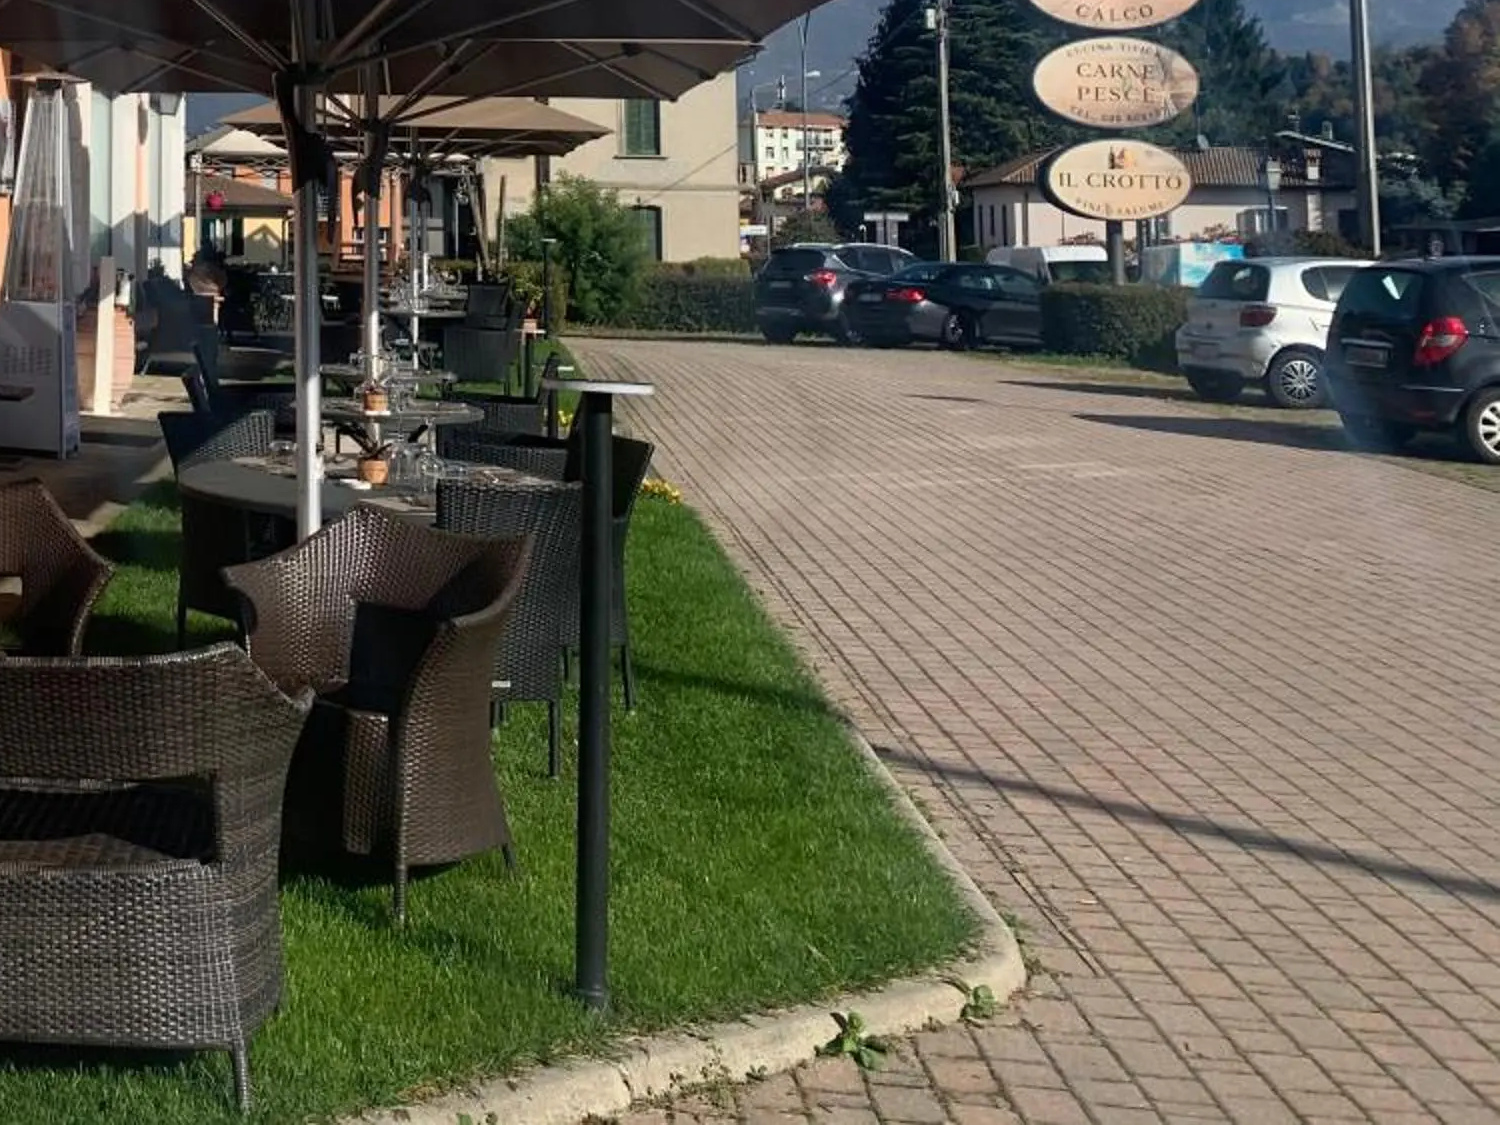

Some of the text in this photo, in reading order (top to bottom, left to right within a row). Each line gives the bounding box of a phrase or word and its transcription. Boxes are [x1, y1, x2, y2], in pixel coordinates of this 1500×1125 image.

[1075, 2, 1153, 22] CALCO
[1076, 62, 1156, 80] CARNE
[1077, 85, 1156, 104] PESCE
[1059, 172, 1183, 190] IL CROTTO
